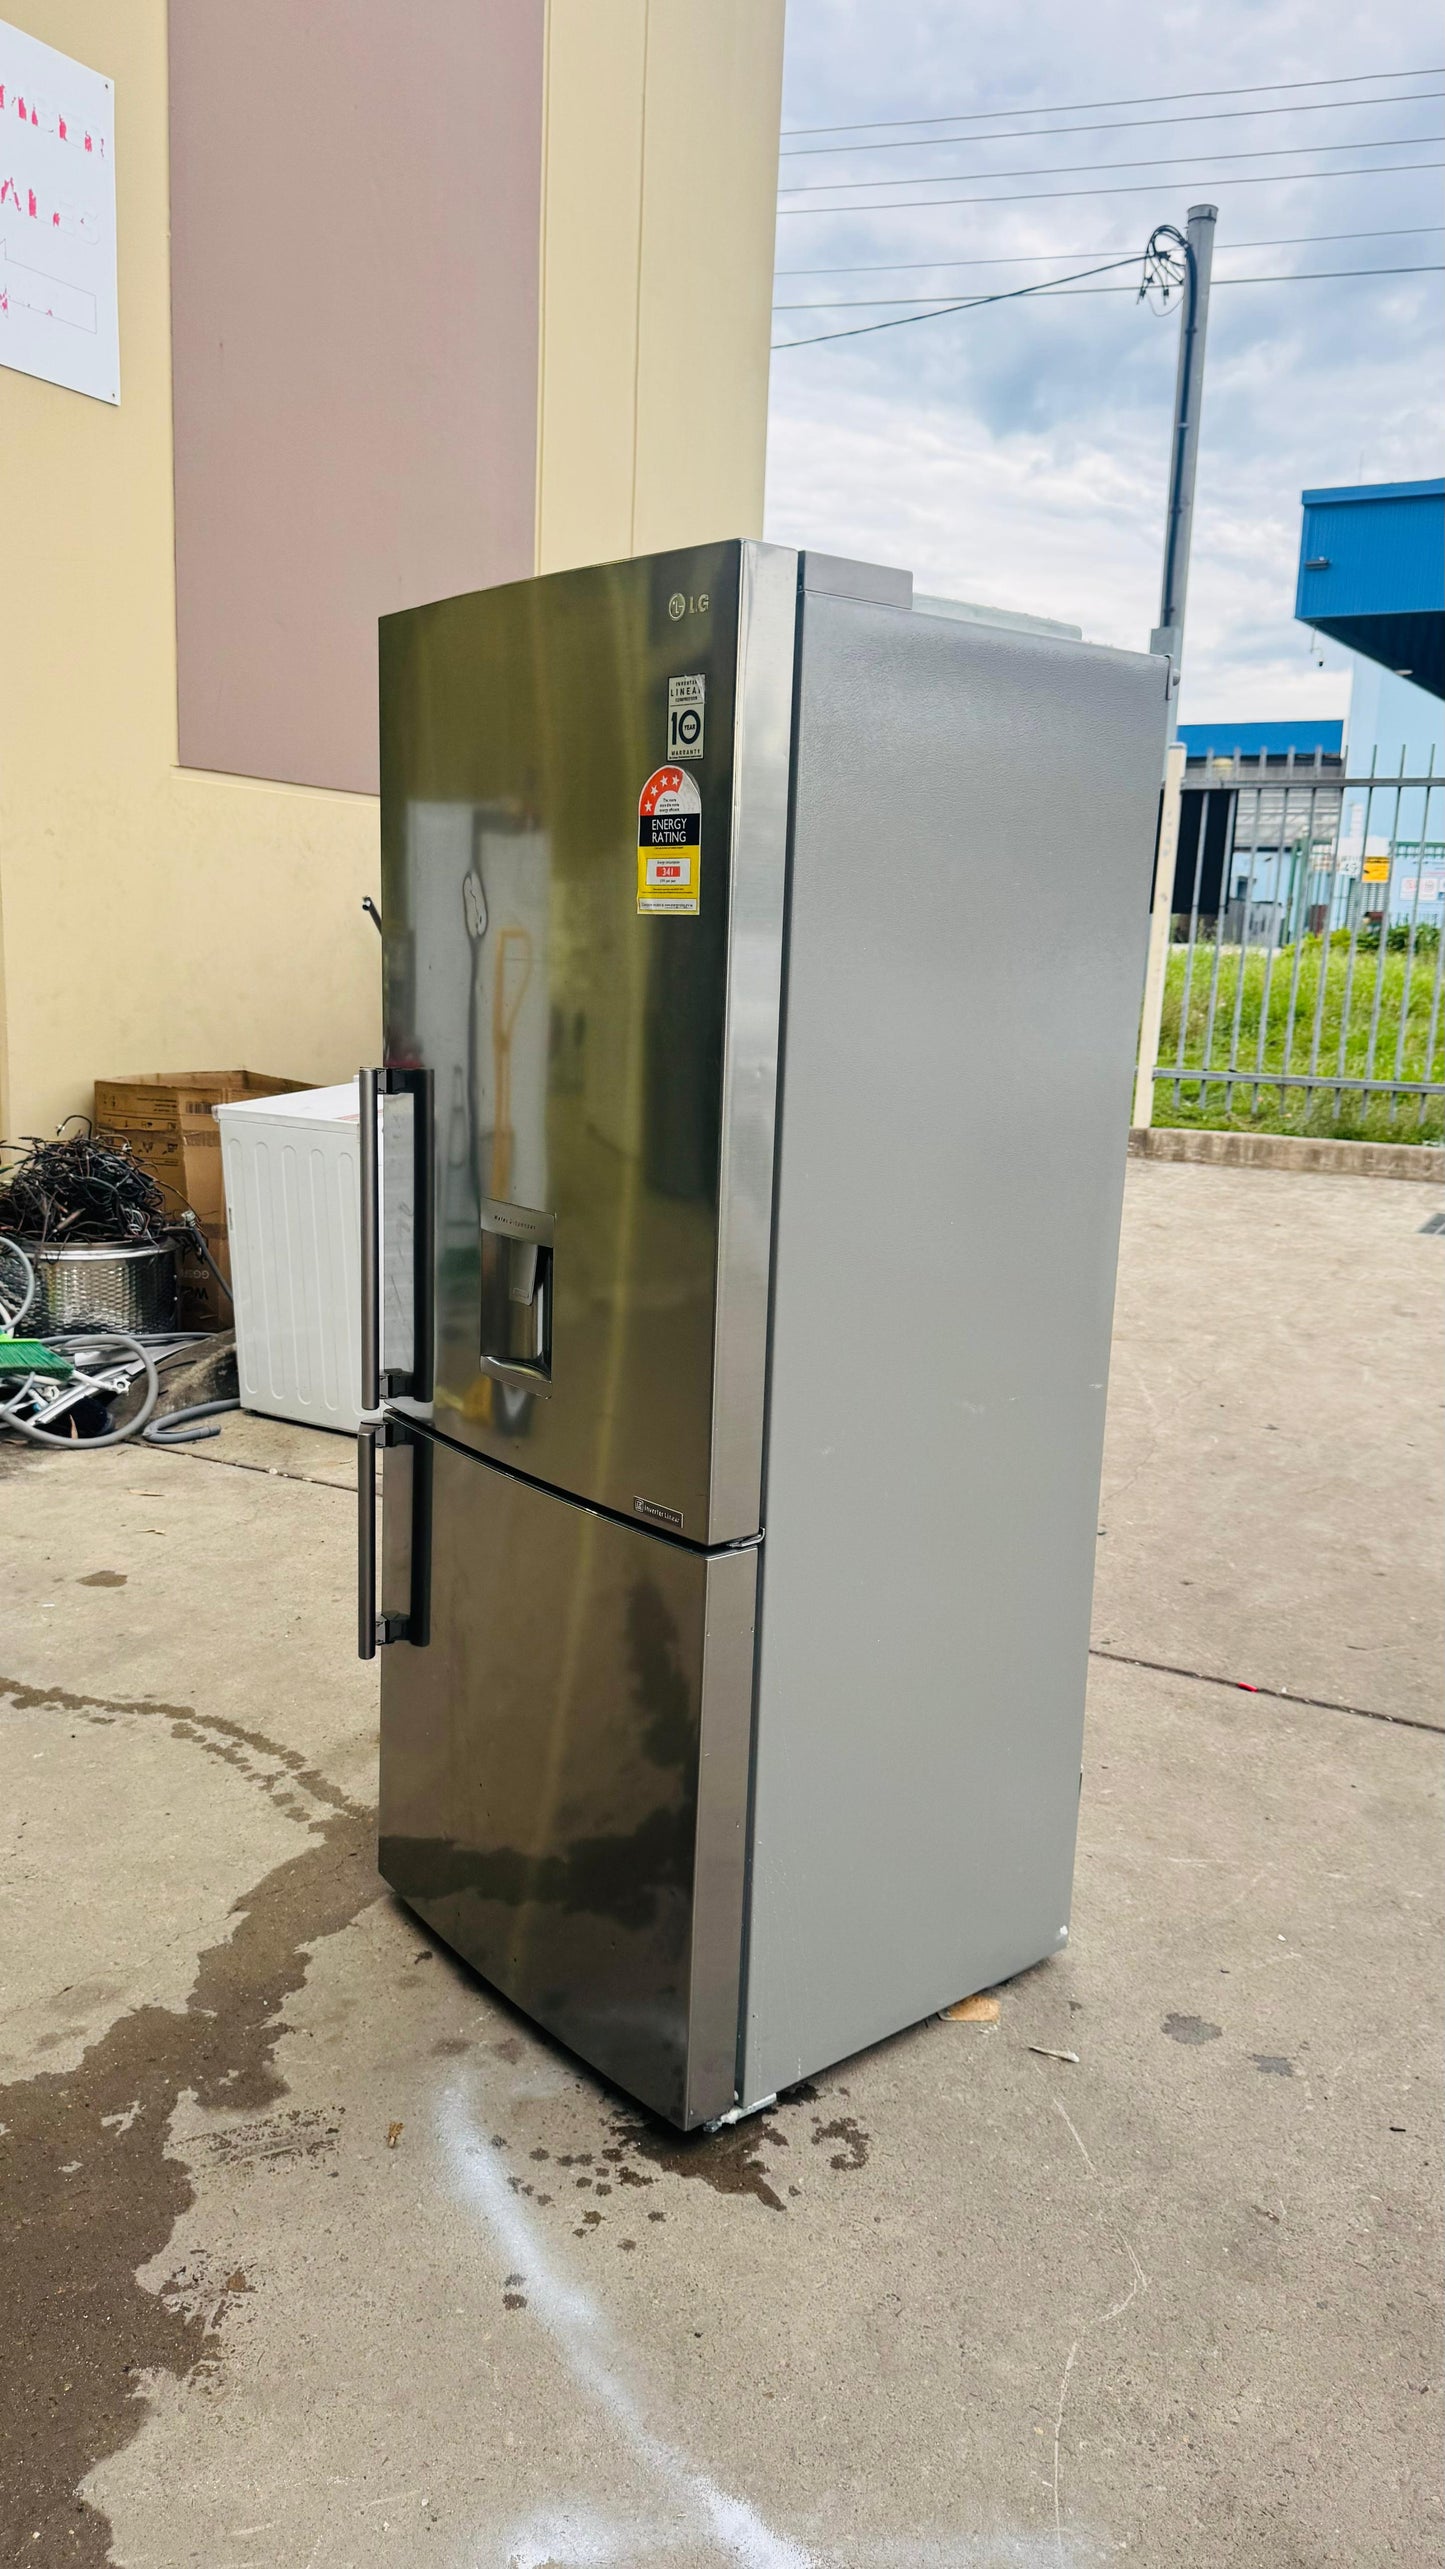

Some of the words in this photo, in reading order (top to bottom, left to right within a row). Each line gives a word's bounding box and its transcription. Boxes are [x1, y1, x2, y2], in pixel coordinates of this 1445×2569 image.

[689, 594, 709, 614] LG
[671, 709, 701, 745] 10
[671, 748, 701, 756] WARRANTY
[651, 818, 688, 831] ENERGY
[651, 830, 687, 843] RATING
